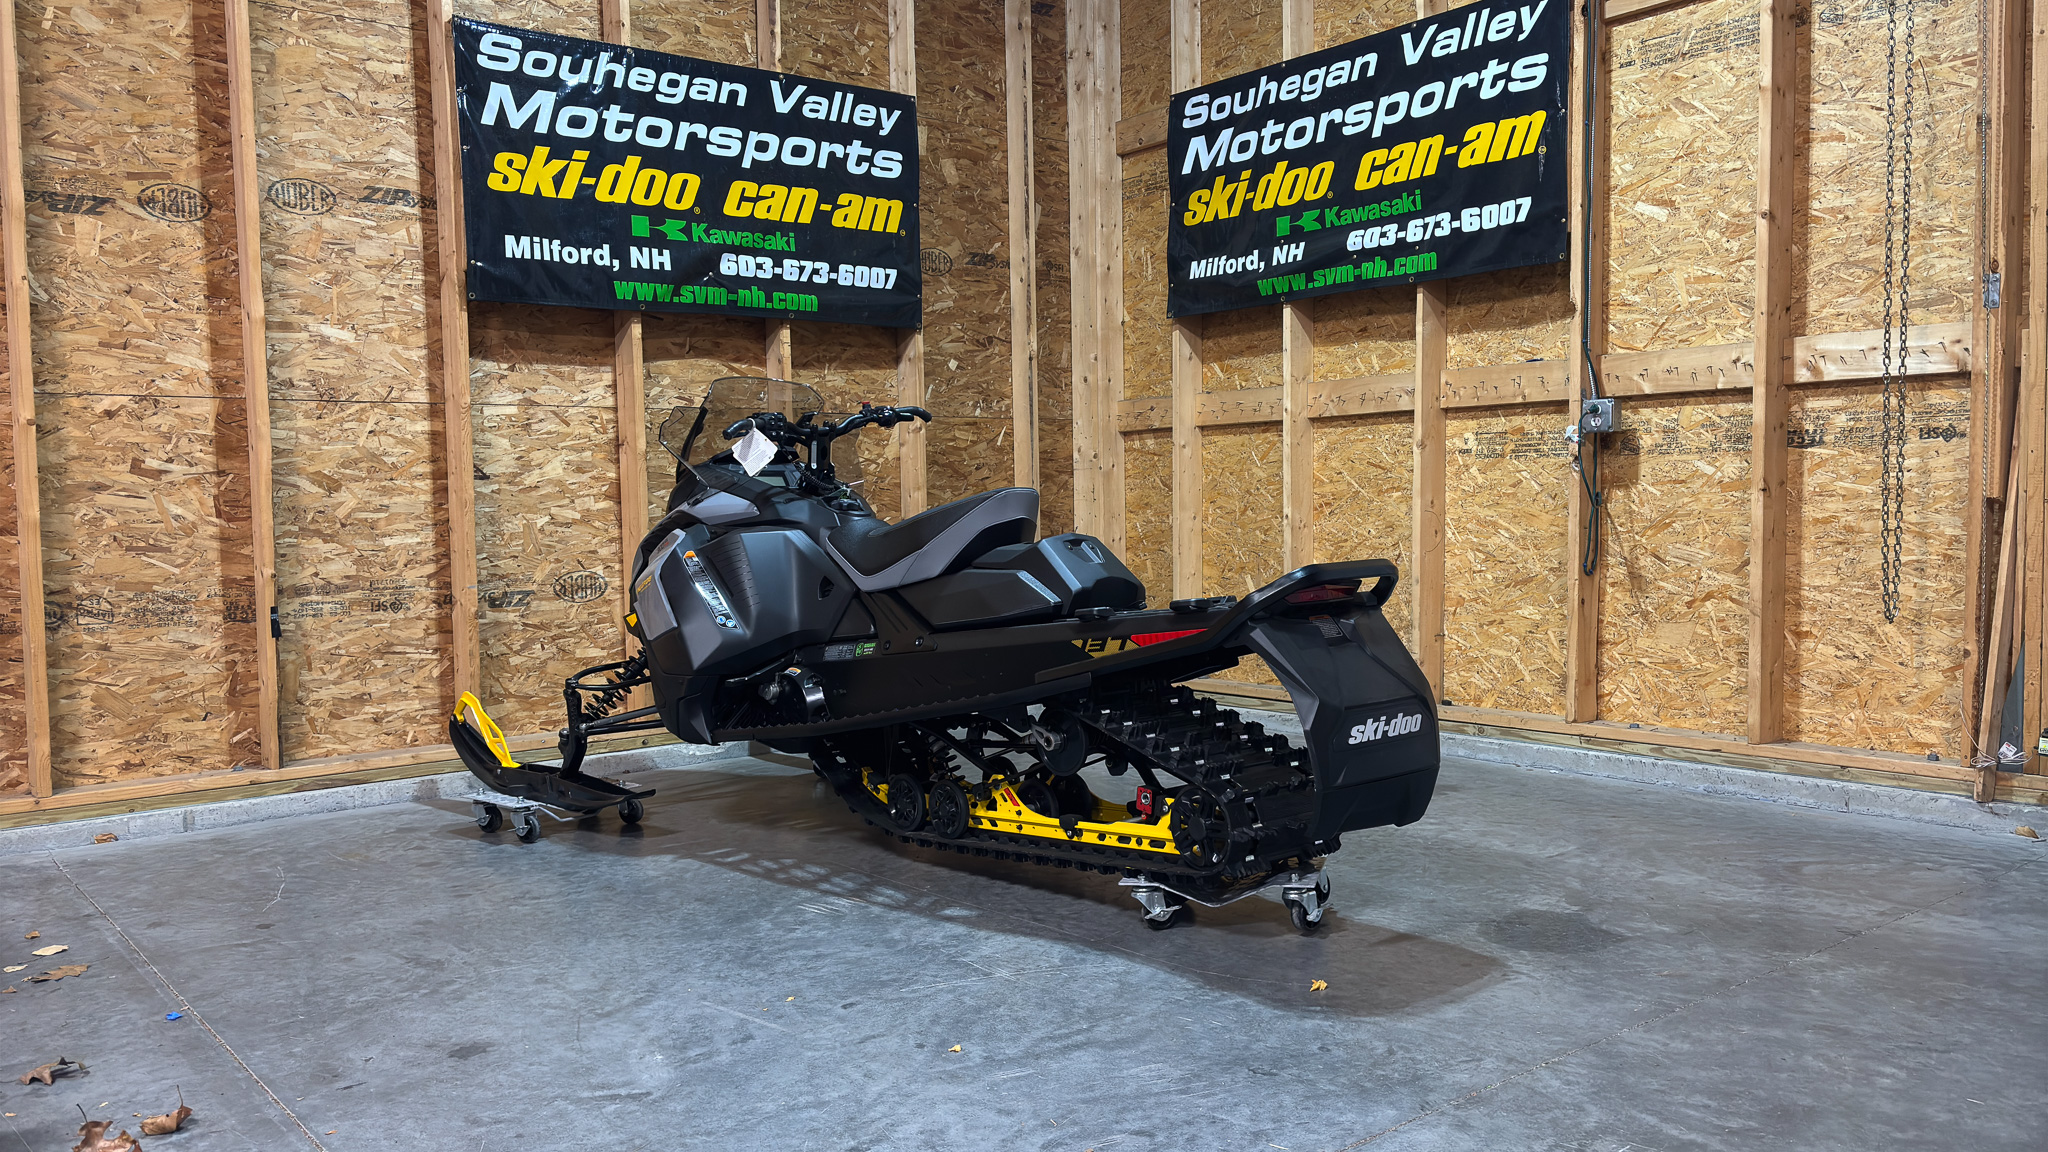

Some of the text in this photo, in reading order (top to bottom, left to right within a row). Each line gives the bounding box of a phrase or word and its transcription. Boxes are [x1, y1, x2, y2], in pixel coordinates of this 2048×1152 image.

[477, 33, 902, 136] Souhegan Valley
[1182, 0, 1549, 129] Souhegan Valley
[481, 82, 904, 179] Motorsports
[1181, 51, 1550, 175] Motorsports
[1325, 189, 1422, 229] Kawasaki
[504, 235, 898, 290] Milford, NH 603-673-6007
[693, 223, 796, 252] Kawasaki
[1189, 196, 1532, 280] Milford, NH 603-673-6007
[613, 279, 818, 312] www.svm-nh.com
[1257, 248, 1438, 297] www.svm-nh.com
[1348, 713, 1422, 745] ski-doo
